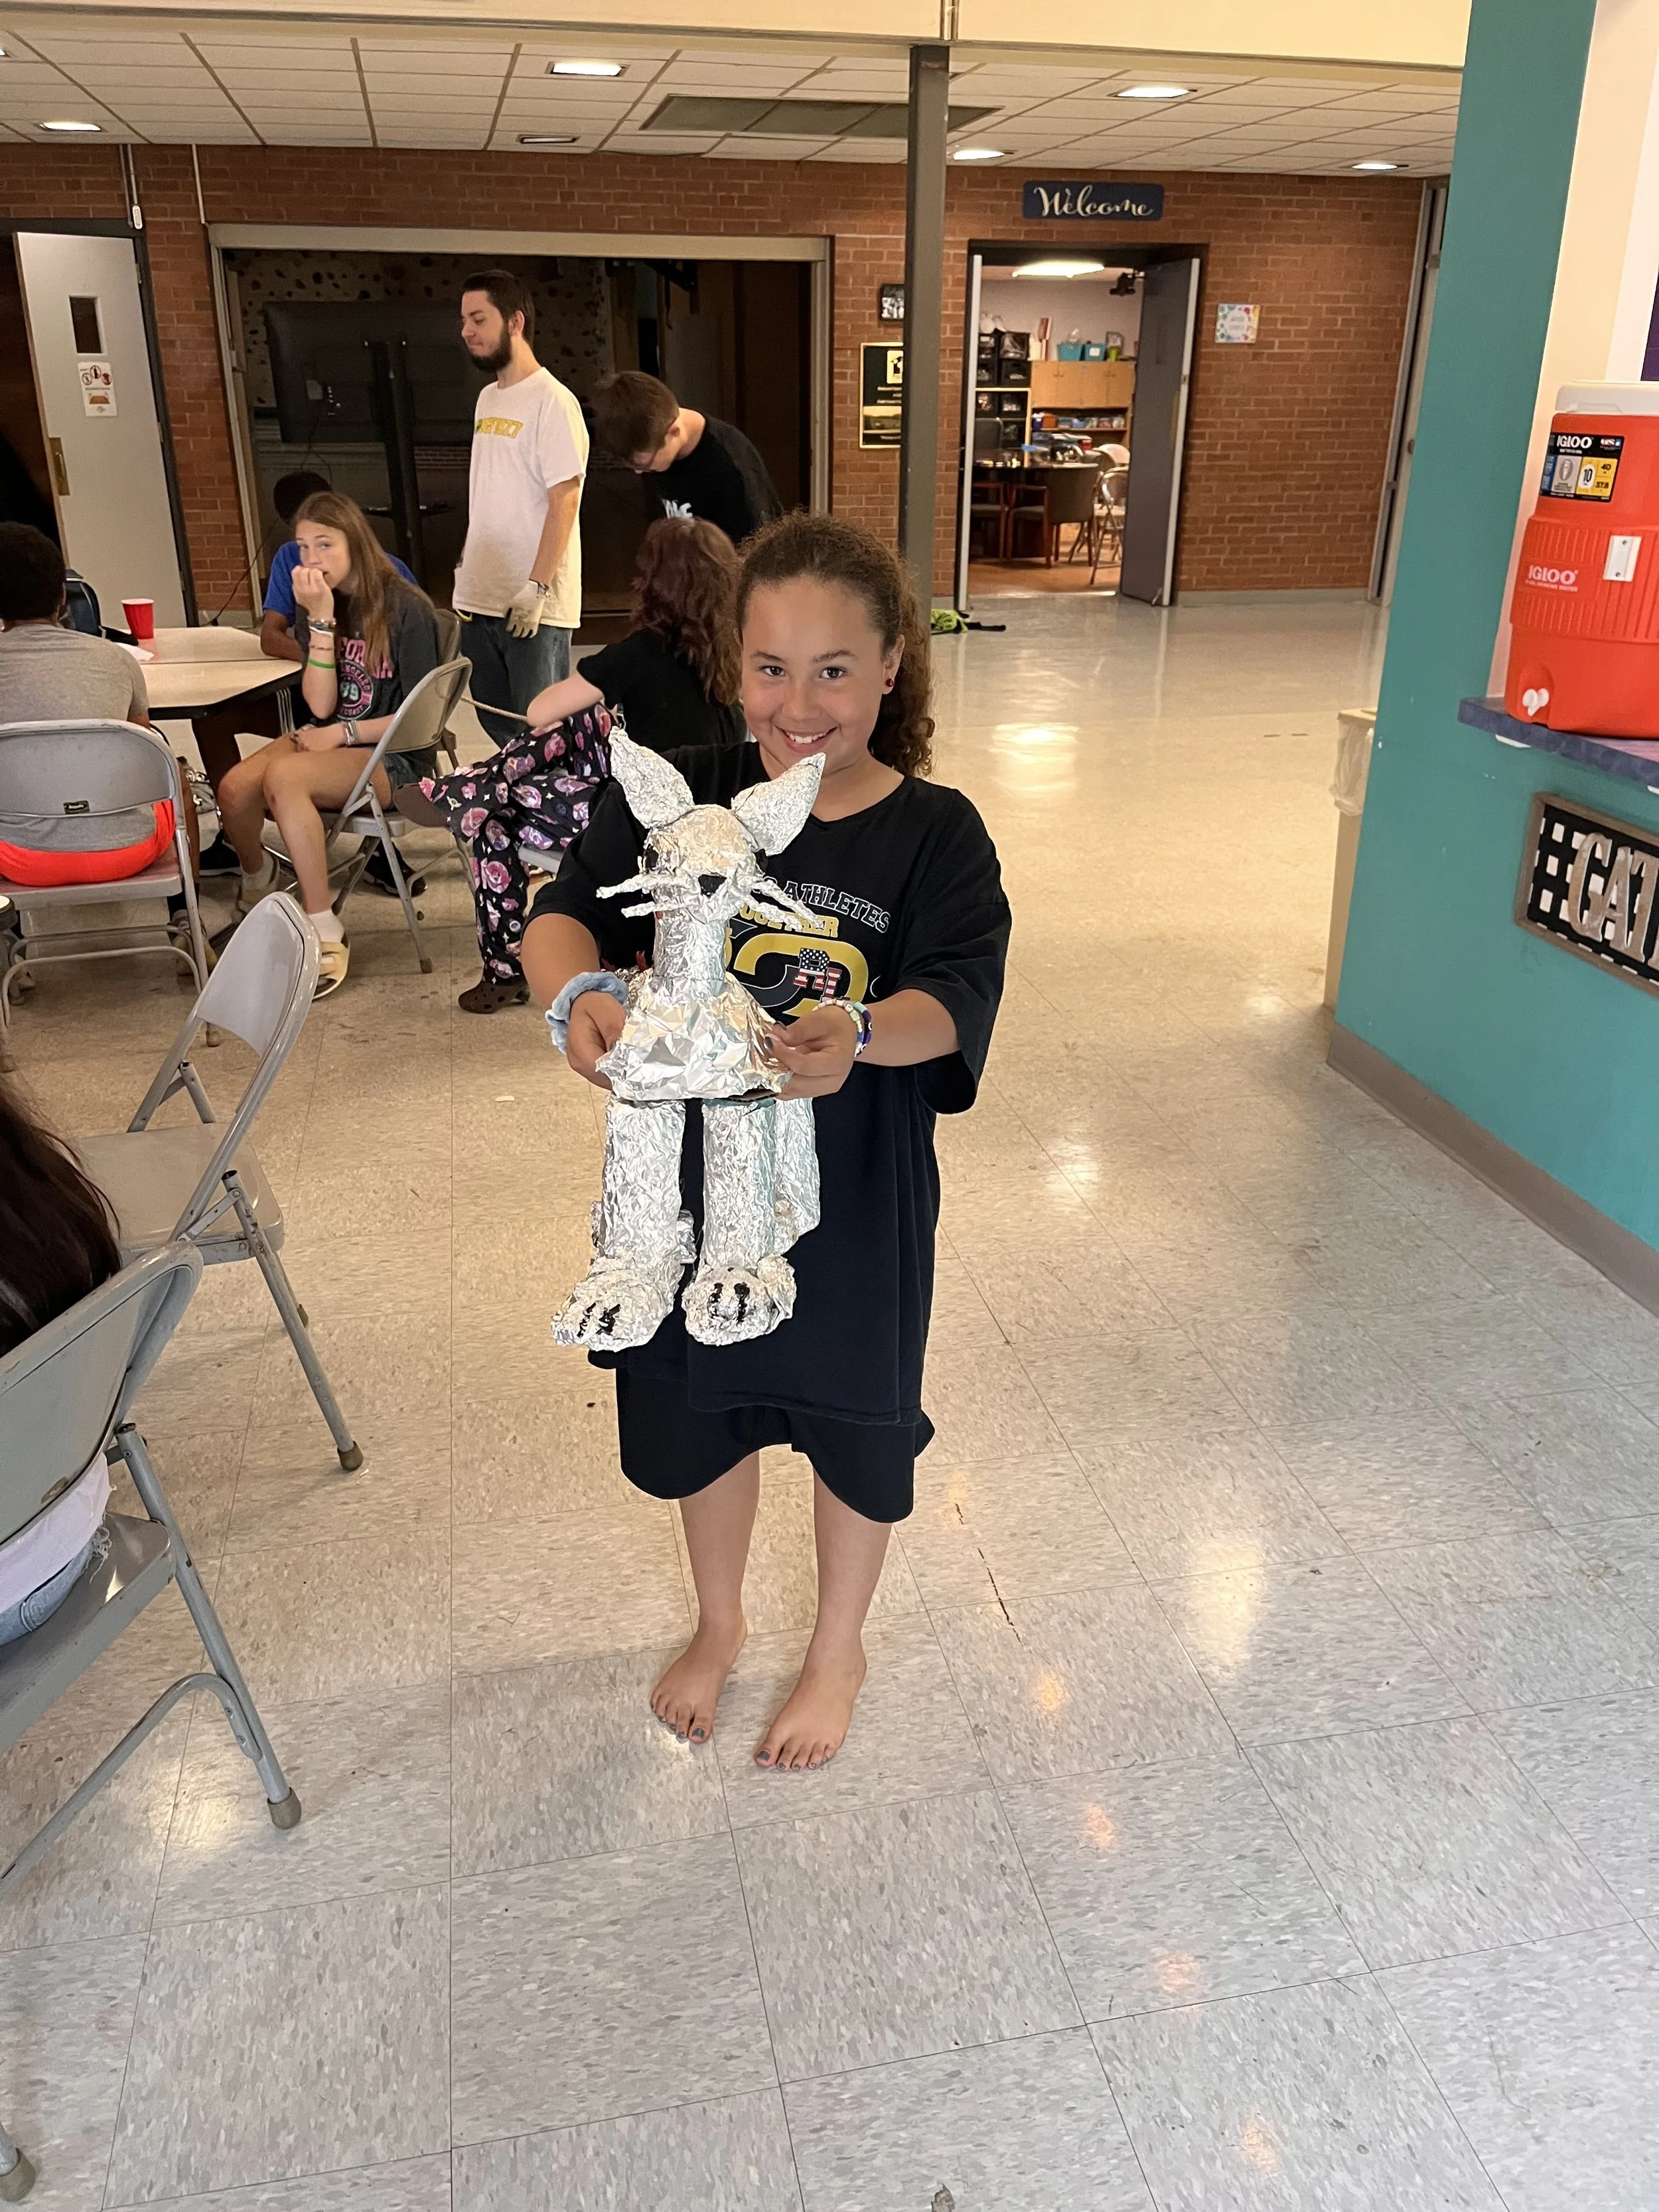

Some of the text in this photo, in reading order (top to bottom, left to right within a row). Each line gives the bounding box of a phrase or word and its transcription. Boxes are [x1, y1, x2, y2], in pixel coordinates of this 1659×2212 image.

[1033, 184, 1153, 217] Welcome
[1556, 435, 1593, 449] IGLOO
[1583, 468, 1593, 482] 10
[1528, 565, 1576, 585] IGLOO
[783, 880, 891, 933] ATHLETES
[1568, 832, 1659, 972] GAT
